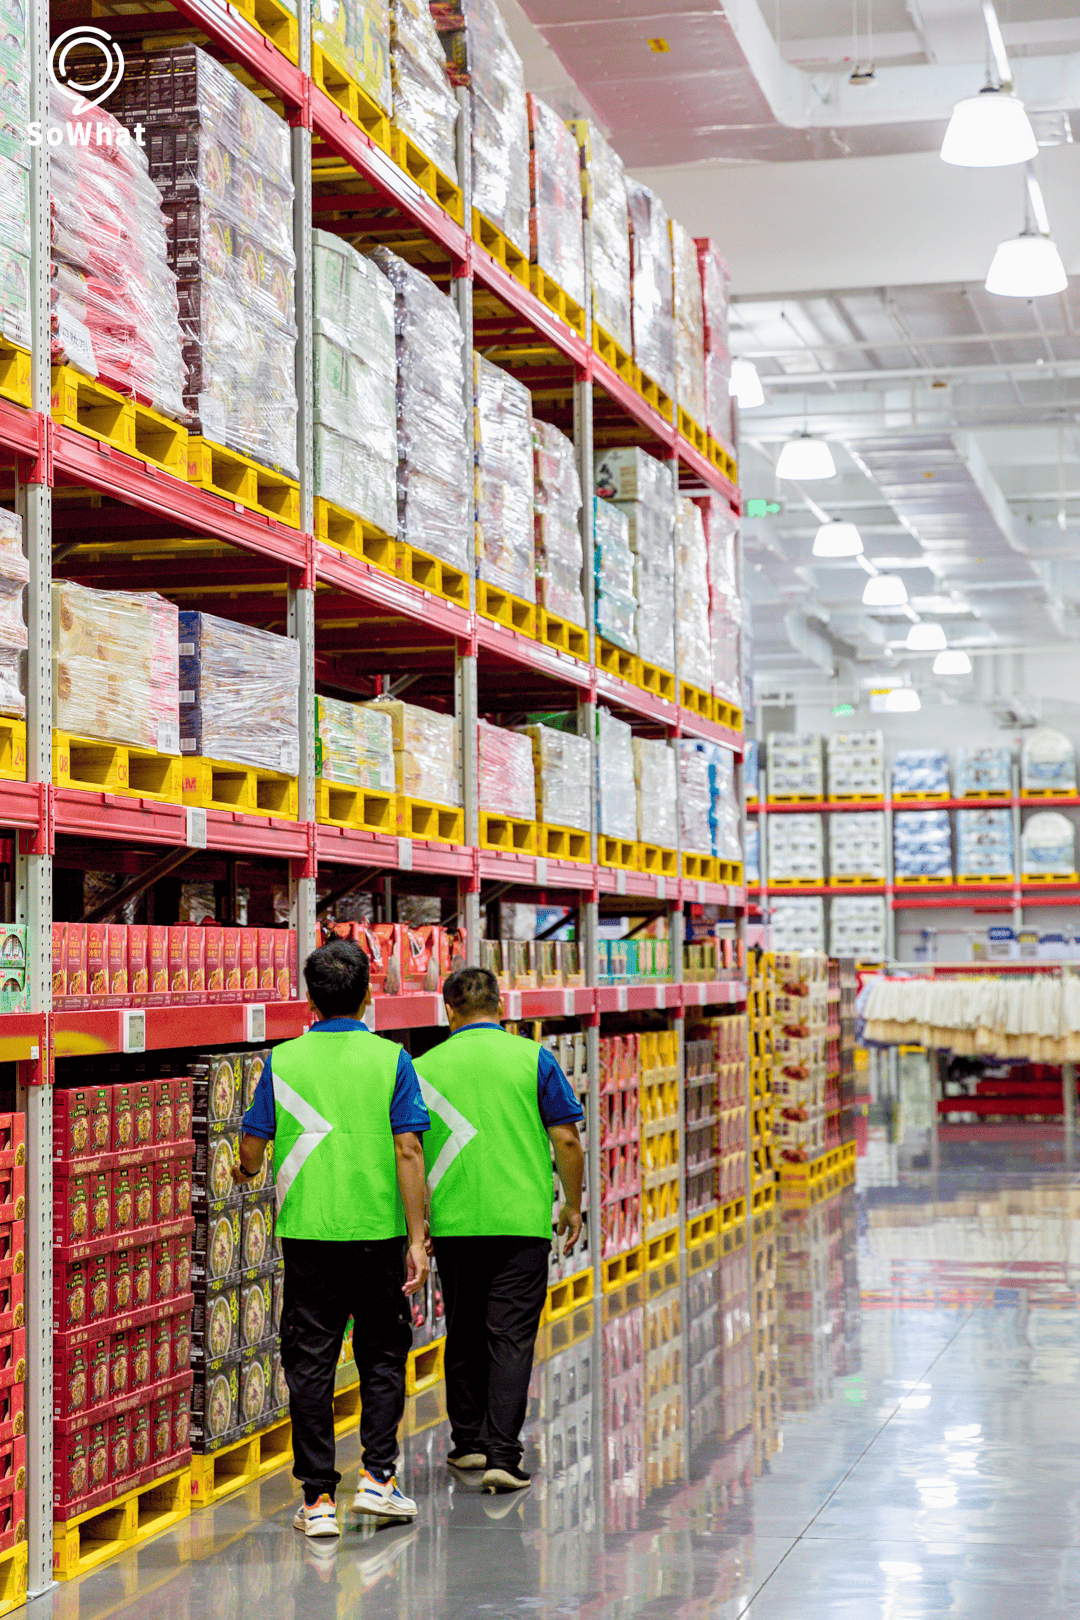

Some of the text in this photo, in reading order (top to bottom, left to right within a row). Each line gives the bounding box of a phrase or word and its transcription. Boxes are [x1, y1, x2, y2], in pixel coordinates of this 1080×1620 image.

[14, 745, 24, 766] 24
[59, 754, 68, 773] 08
[117, 764, 128, 782] CR
